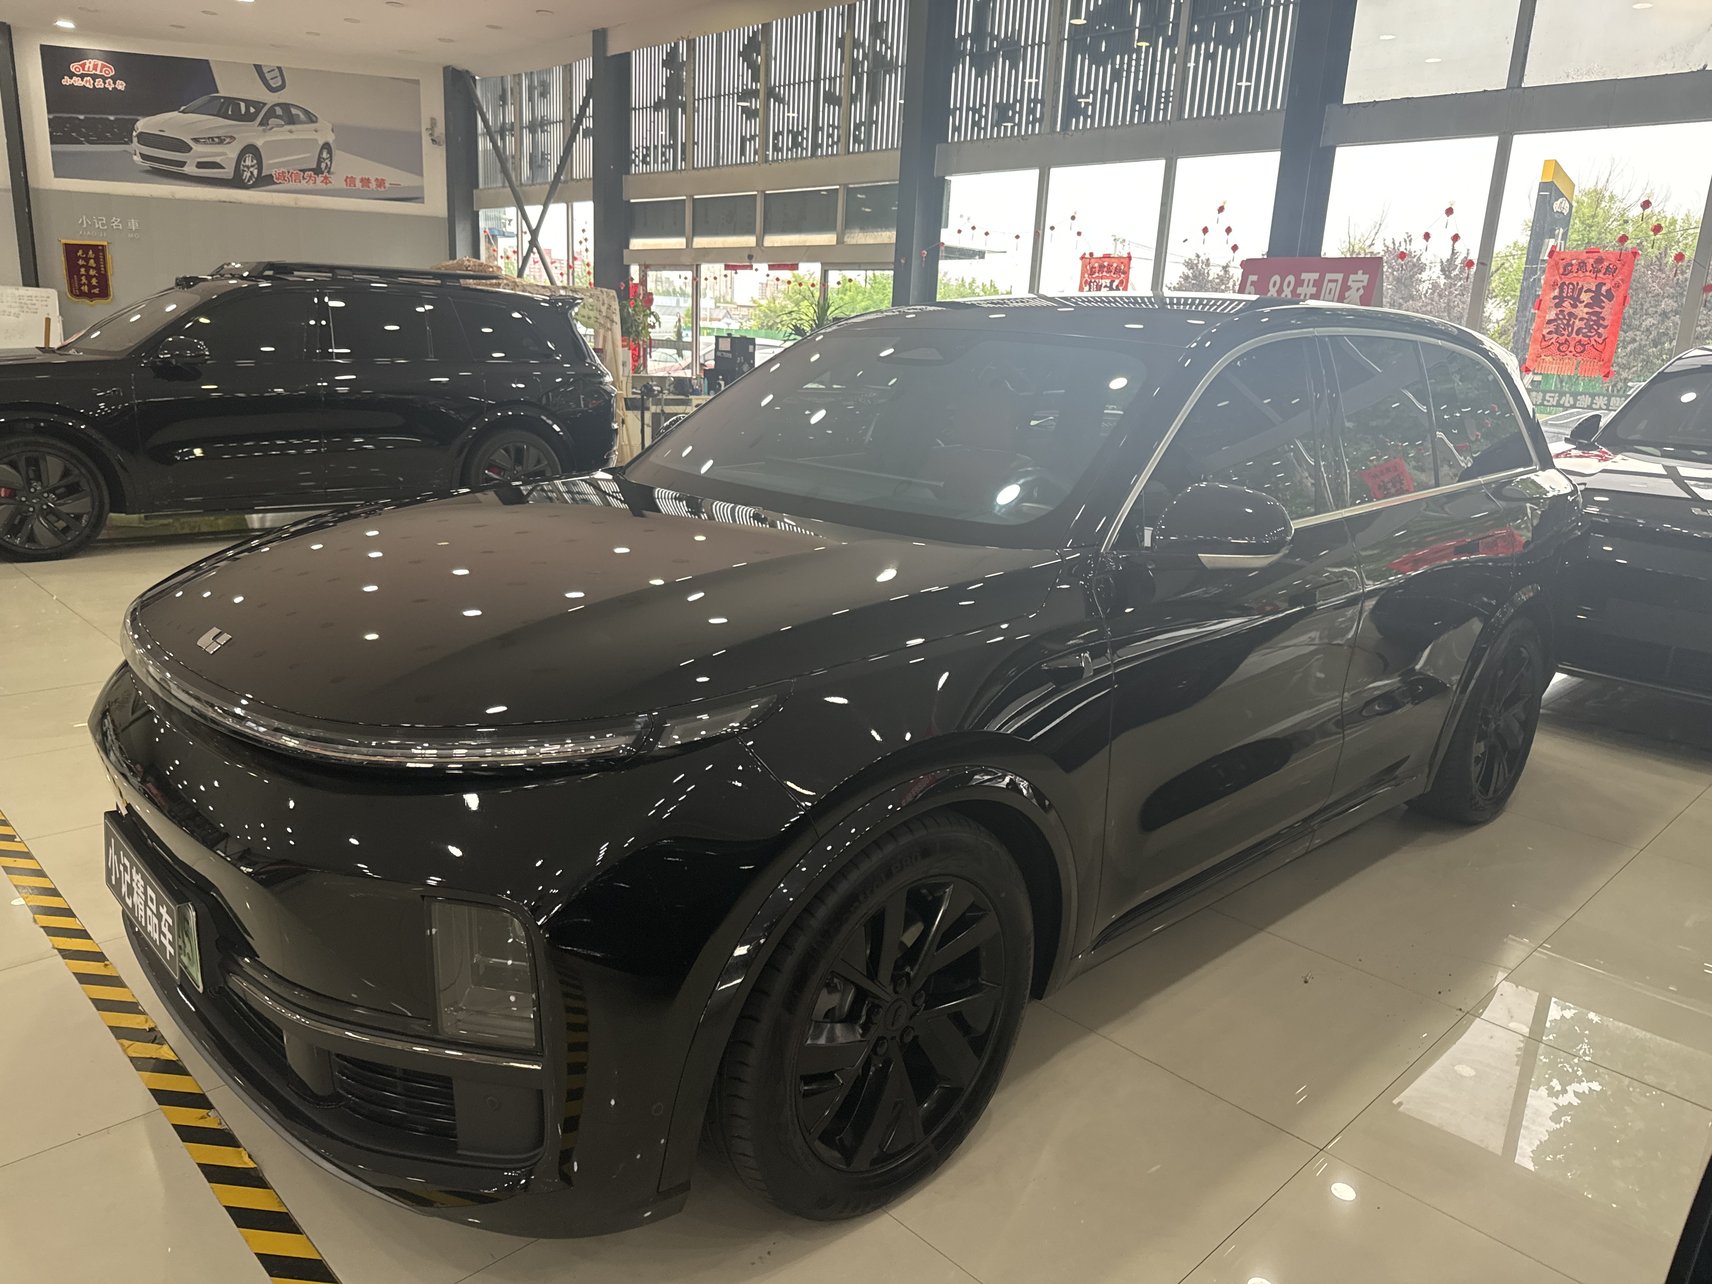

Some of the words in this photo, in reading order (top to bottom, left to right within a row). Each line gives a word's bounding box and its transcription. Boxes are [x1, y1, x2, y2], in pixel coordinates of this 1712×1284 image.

[273, 169, 333, 187] 诚信为本
[344, 175, 401, 191] 信誉第一
[1244, 270, 1370, 305] 588开回家
[108, 837, 175, 960] 小记精品车
